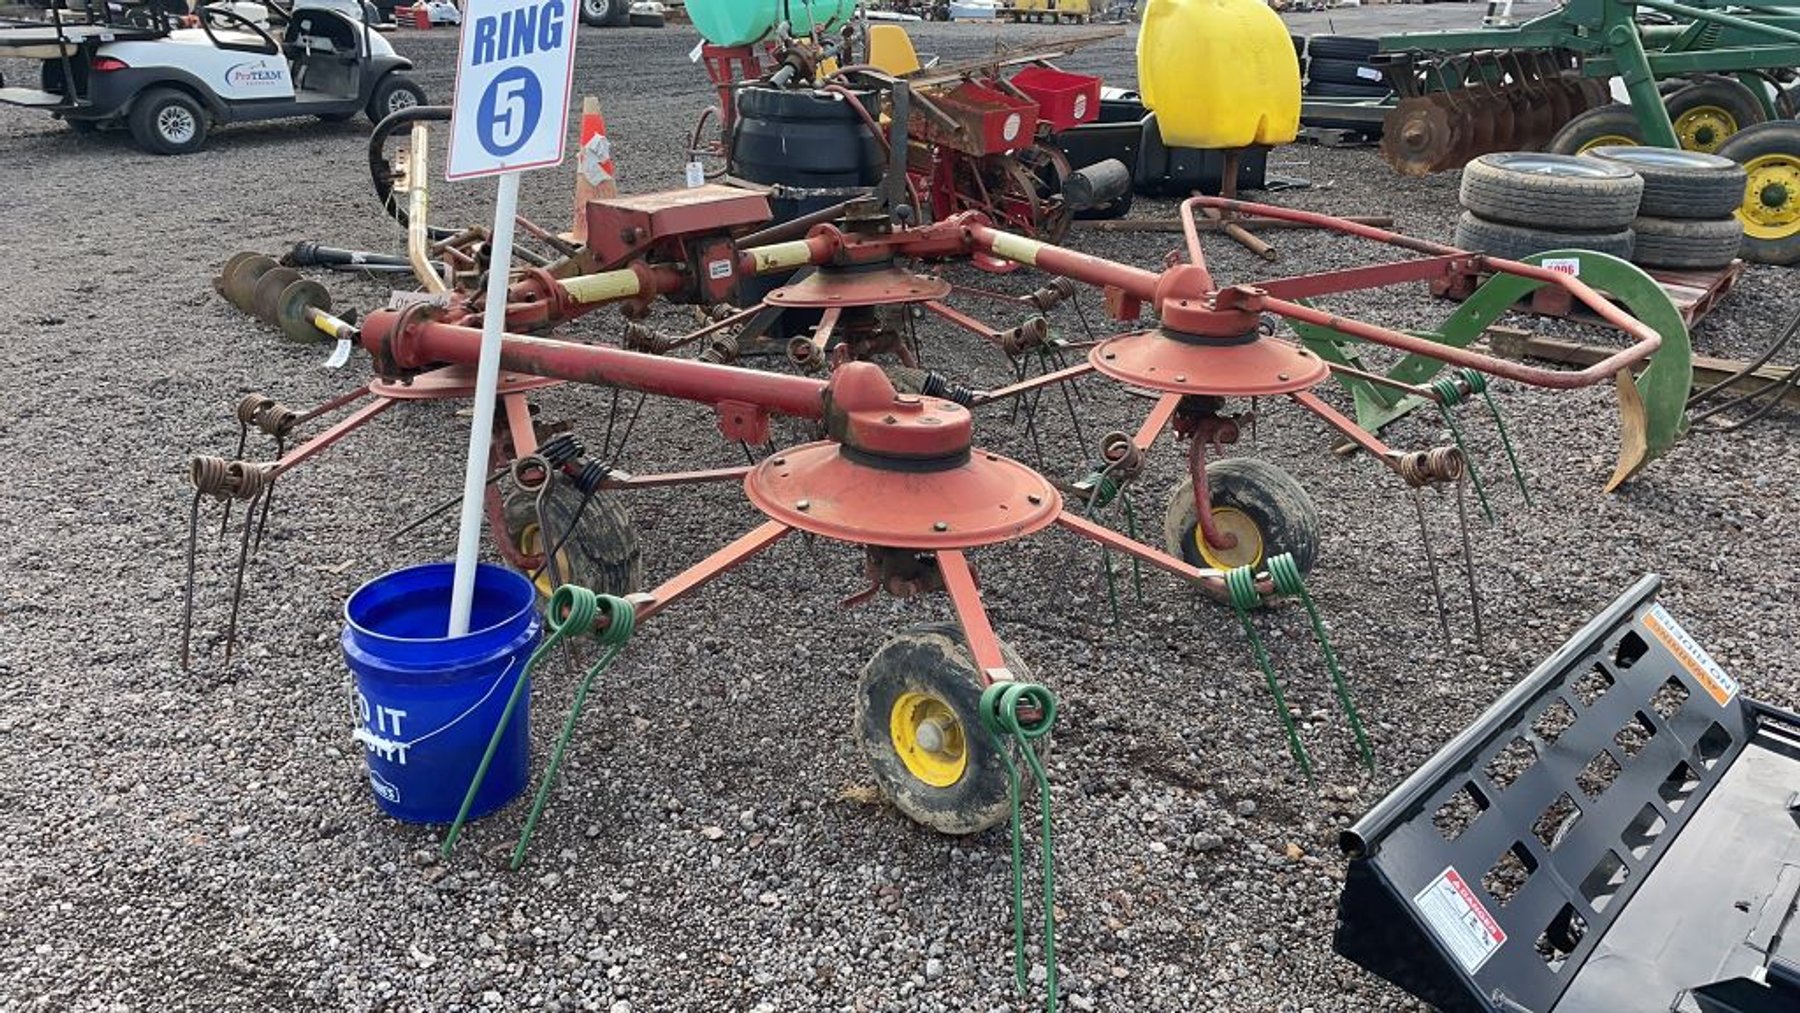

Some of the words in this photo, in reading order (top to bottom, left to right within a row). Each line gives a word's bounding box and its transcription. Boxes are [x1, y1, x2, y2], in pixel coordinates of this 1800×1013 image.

[472, 0, 565, 66] RING
[491, 77, 526, 148] 5
[1653, 621, 1709, 681] WARNING
[1654, 609, 1708, 665] RIDERS
[1709, 667, 1732, 690] NO
[376, 704, 407, 736] IT
[1459, 886, 1498, 935] DANGER
